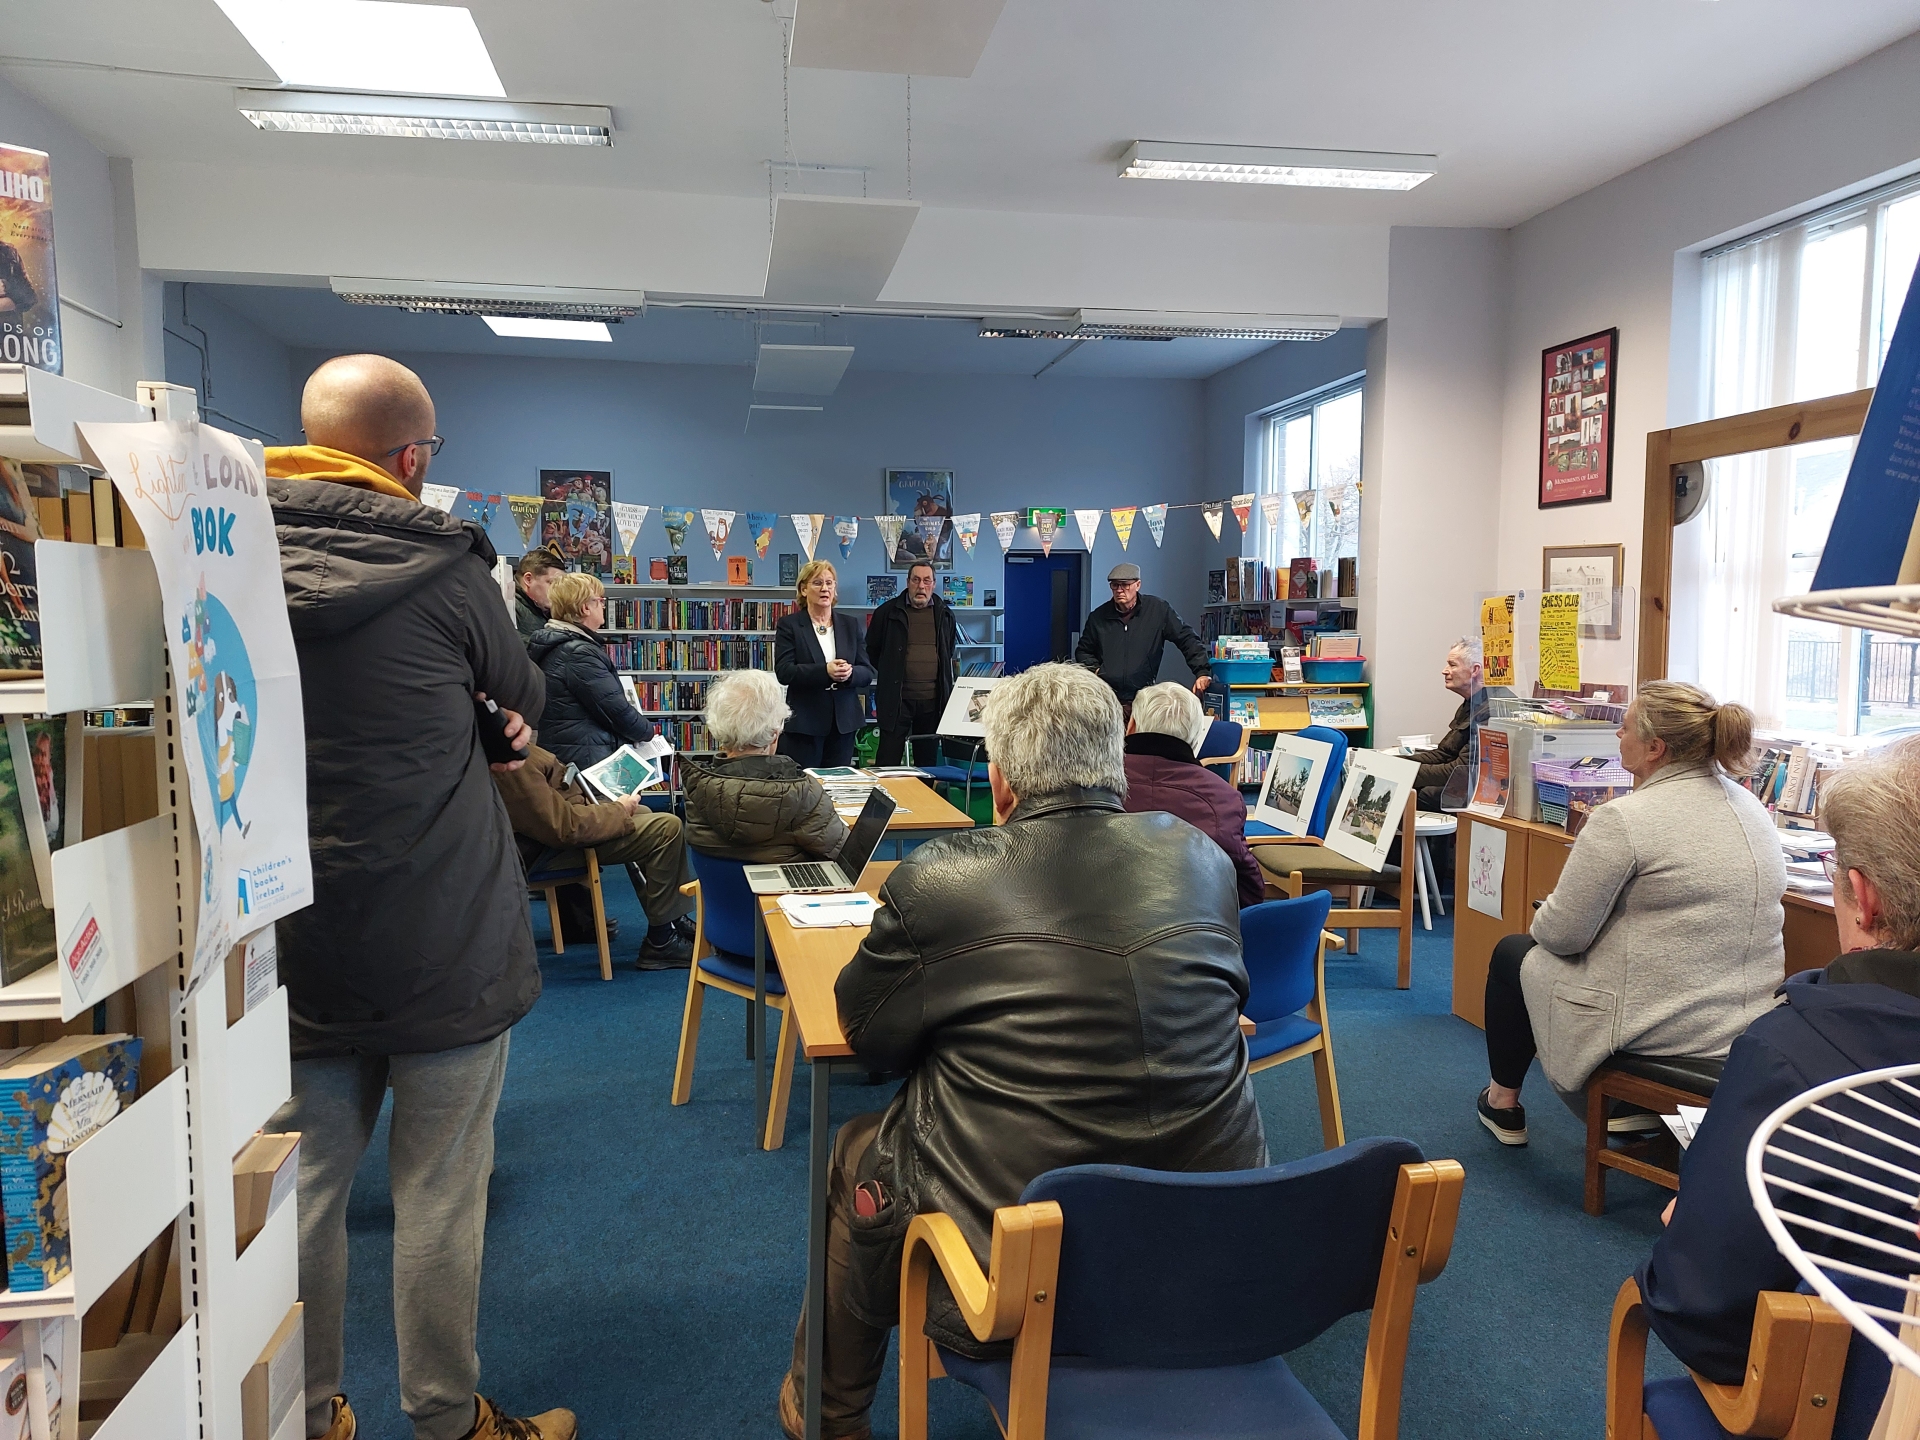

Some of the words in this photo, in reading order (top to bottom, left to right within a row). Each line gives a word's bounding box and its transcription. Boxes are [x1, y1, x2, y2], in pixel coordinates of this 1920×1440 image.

[33, 326, 54, 337] OF
[0, 334, 58, 366] ONG
[1541, 594, 1563, 609] CHESS
[1564, 593, 1580, 608] CLUB
[1793, 755, 1803, 774] DAN
[1787, 774, 1798, 798] JONES
[253, 855, 292, 876] children's
[254, 874, 278, 889] books
[255, 882, 285, 901] ireland
